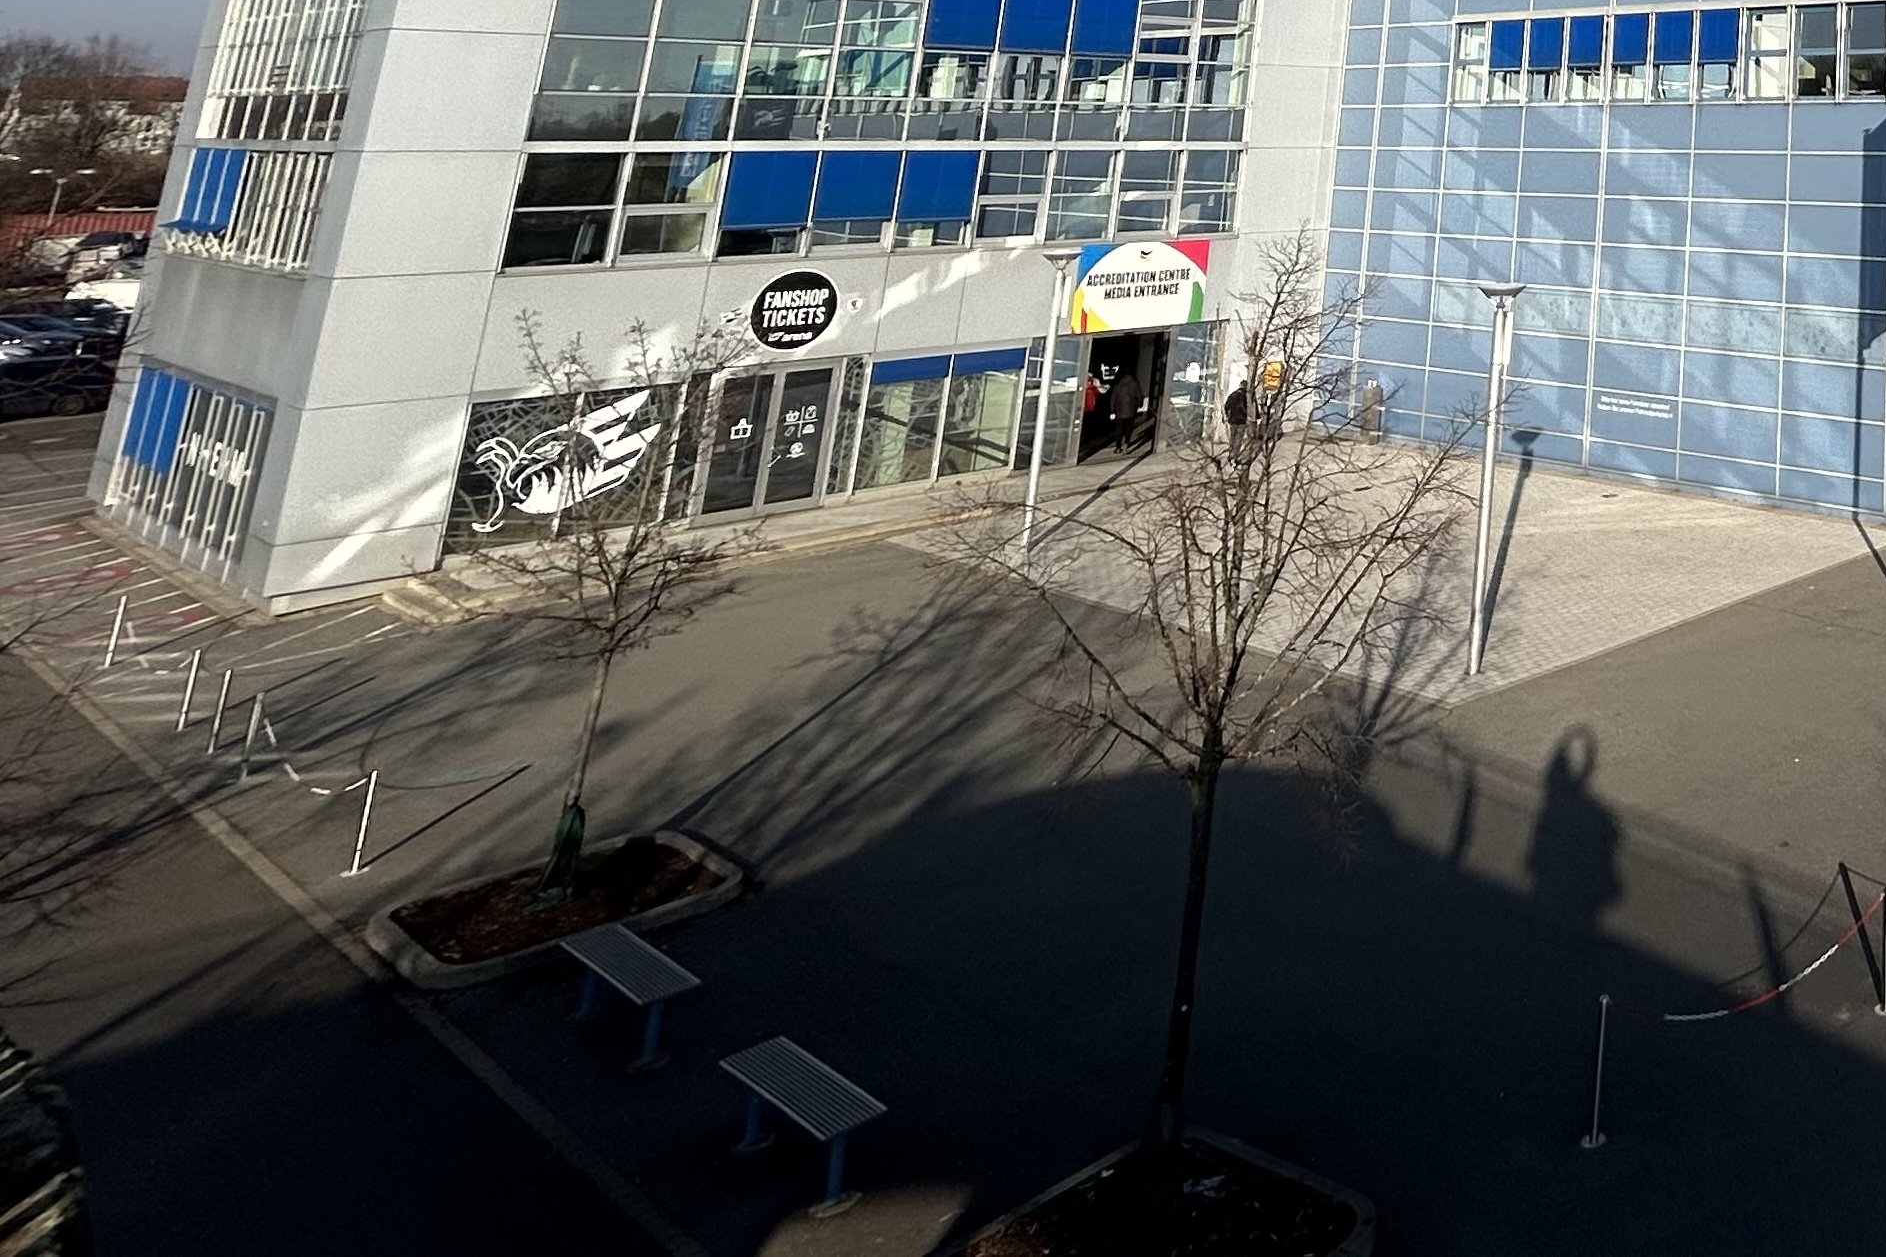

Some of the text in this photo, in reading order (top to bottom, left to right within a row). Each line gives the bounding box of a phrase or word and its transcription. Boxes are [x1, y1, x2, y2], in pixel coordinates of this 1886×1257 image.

[1087, 268, 1191, 287] ACCREDITATION CENTRE
[763, 288, 830, 309] FANSHOP
[1104, 282, 1180, 300] MEDIA ENTRANCE
[762, 307, 826, 328] TICKETS
